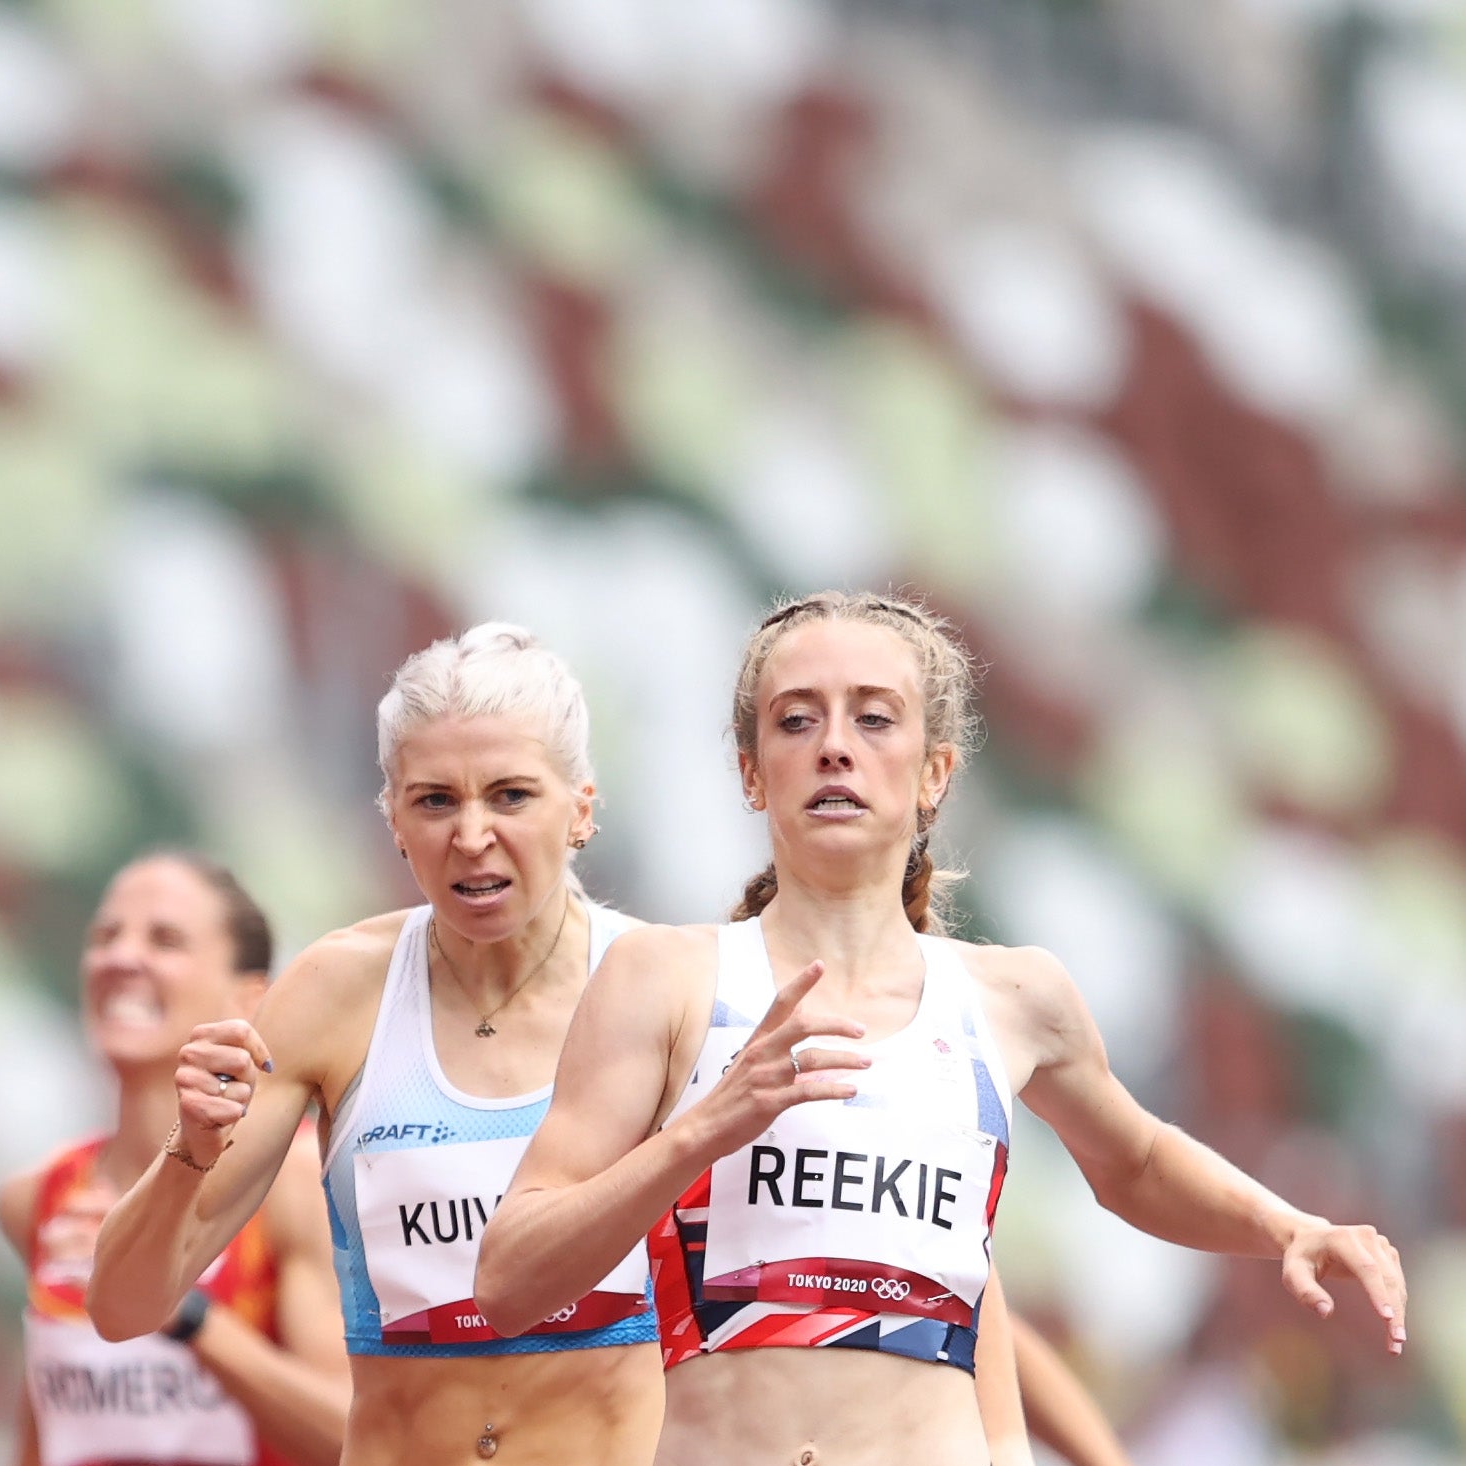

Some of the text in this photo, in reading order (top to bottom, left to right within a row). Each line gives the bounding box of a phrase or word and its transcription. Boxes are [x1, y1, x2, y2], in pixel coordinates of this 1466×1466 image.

[358, 1124, 432, 1144] CRAFT
[748, 1145, 962, 1230] REEKIE
[787, 1274, 867, 1293] TOKYO 2020
